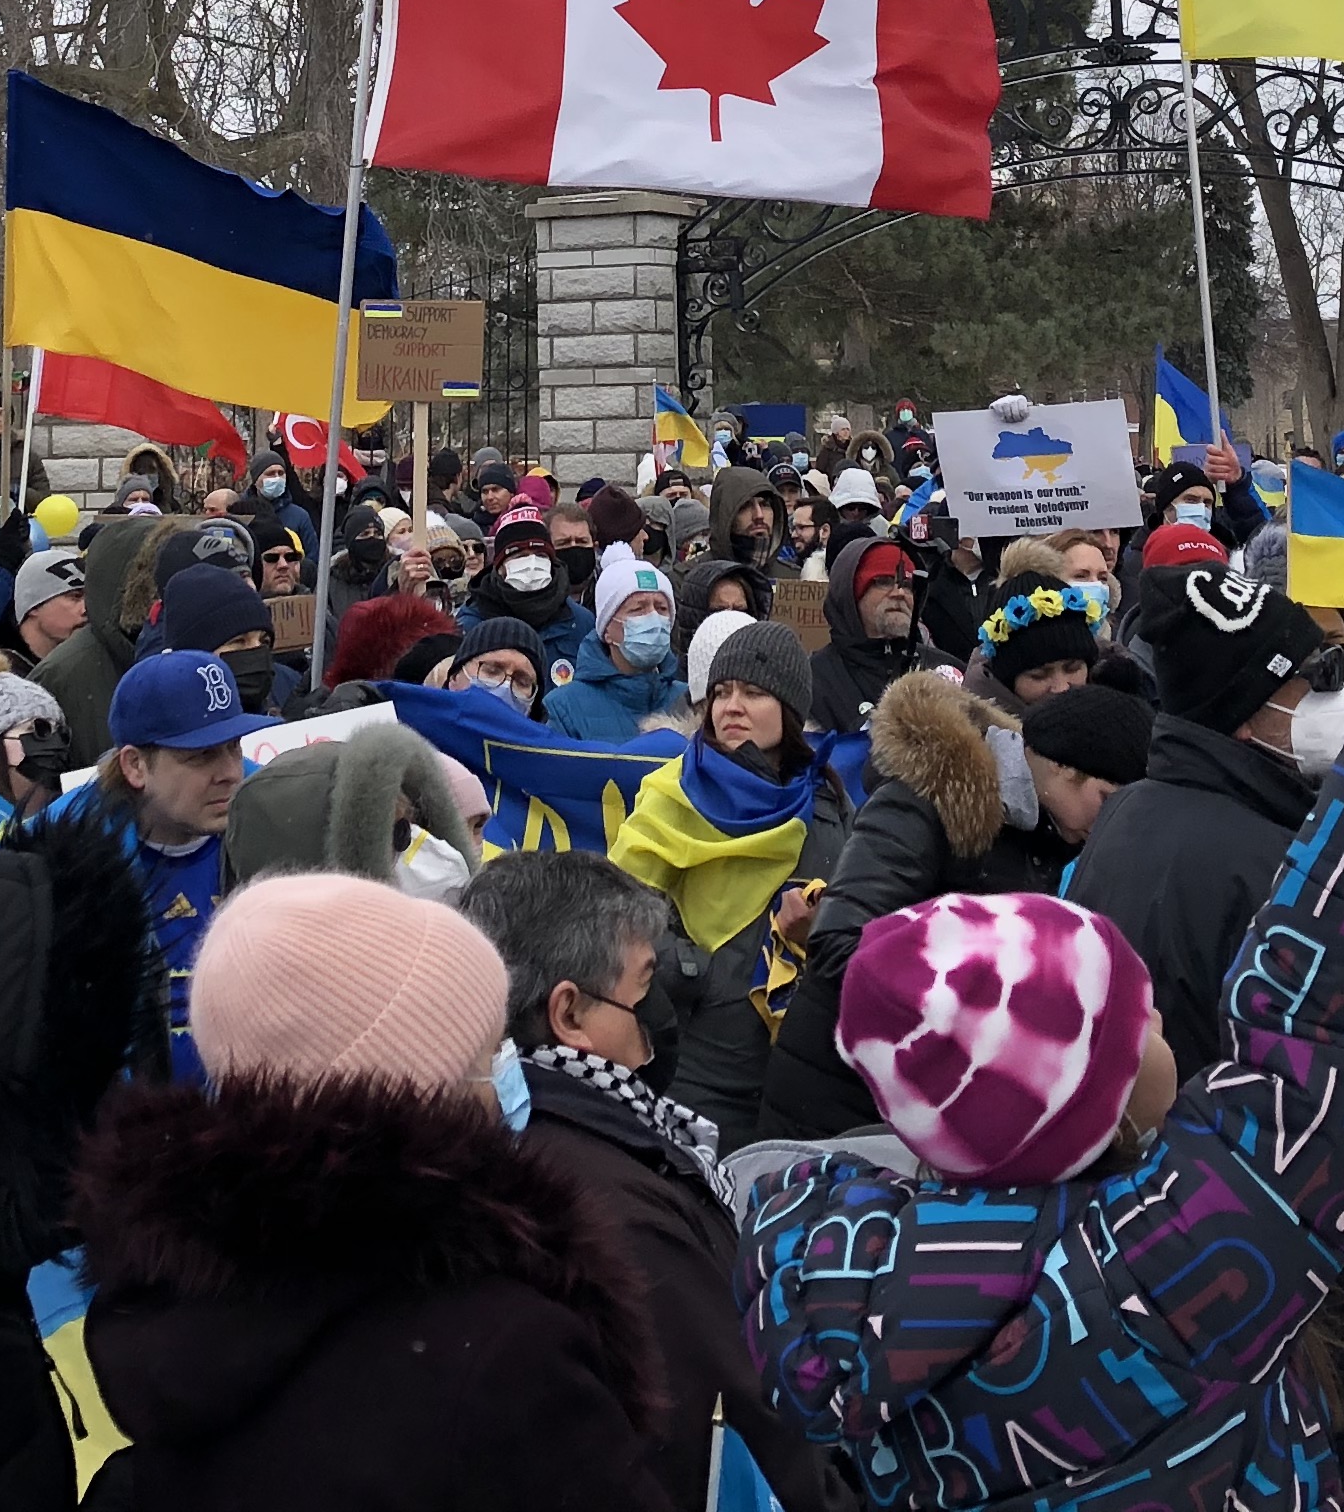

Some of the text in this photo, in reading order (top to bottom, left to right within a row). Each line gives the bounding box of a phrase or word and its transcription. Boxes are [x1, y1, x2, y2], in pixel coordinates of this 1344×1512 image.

[405, 305, 457, 323] SUPPORT
[367, 324, 427, 340] DEMOCRACY
[393, 342, 454, 358] SUPPORT
[364, 364, 445, 393] UKRAINE
[985, 491, 1023, 502] weapon
[1024, 489, 1034, 500] is
[1037, 488, 1054, 498] our
[988, 500, 1090, 515] President Volodymyr
[778, 582, 826, 601] DEFEND
[197, 663, 232, 711] B
